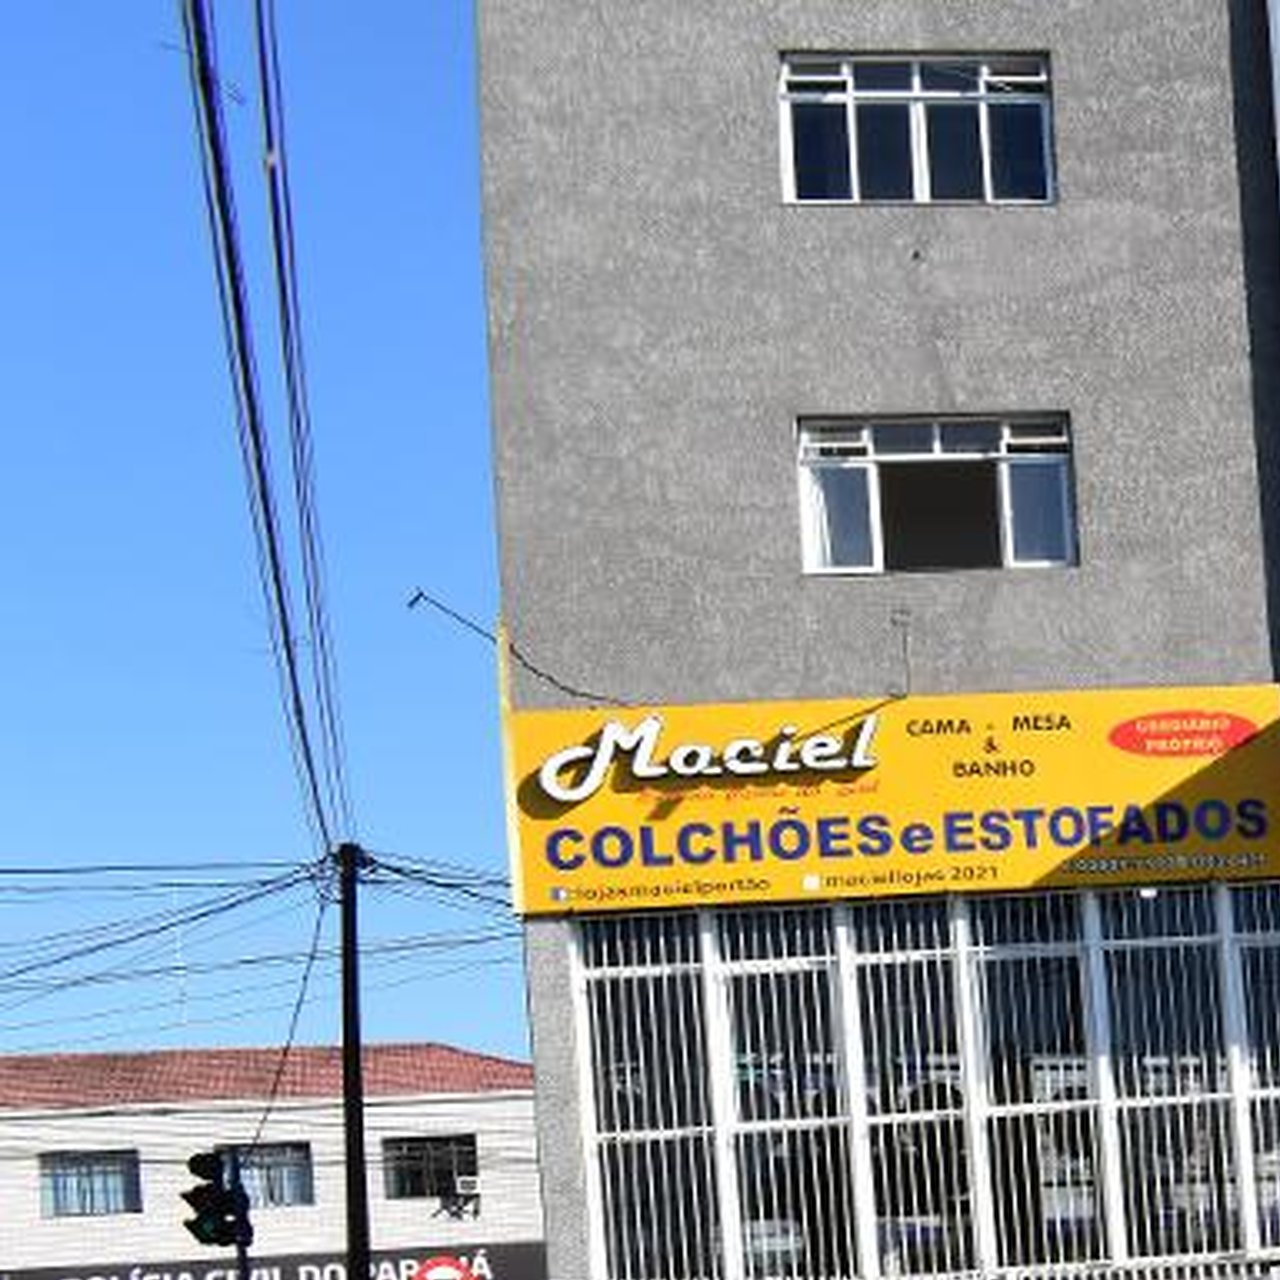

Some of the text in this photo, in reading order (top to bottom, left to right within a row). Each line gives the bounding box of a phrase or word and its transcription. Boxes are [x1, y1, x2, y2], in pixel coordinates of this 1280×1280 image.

[906, 715, 1072, 737] CAMA MESA
[539, 713, 878, 801] Maciel
[953, 759, 1036, 778] BANHO
